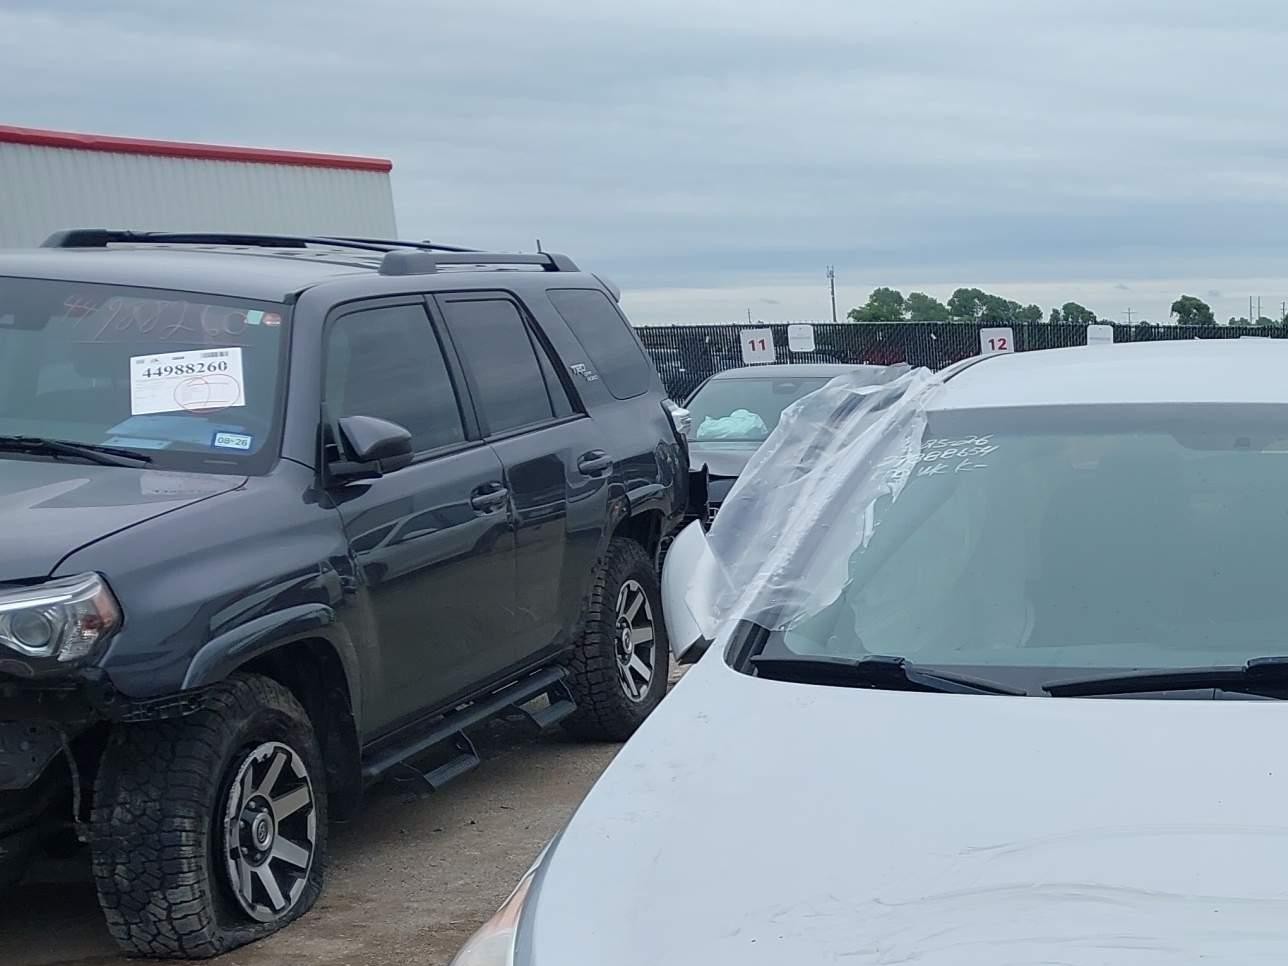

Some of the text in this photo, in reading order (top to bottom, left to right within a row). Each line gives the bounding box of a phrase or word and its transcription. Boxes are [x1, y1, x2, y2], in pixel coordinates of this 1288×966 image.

[748, 339, 766, 352] 11
[987, 337, 1008, 351] 12
[142, 360, 228, 378] 44988260
